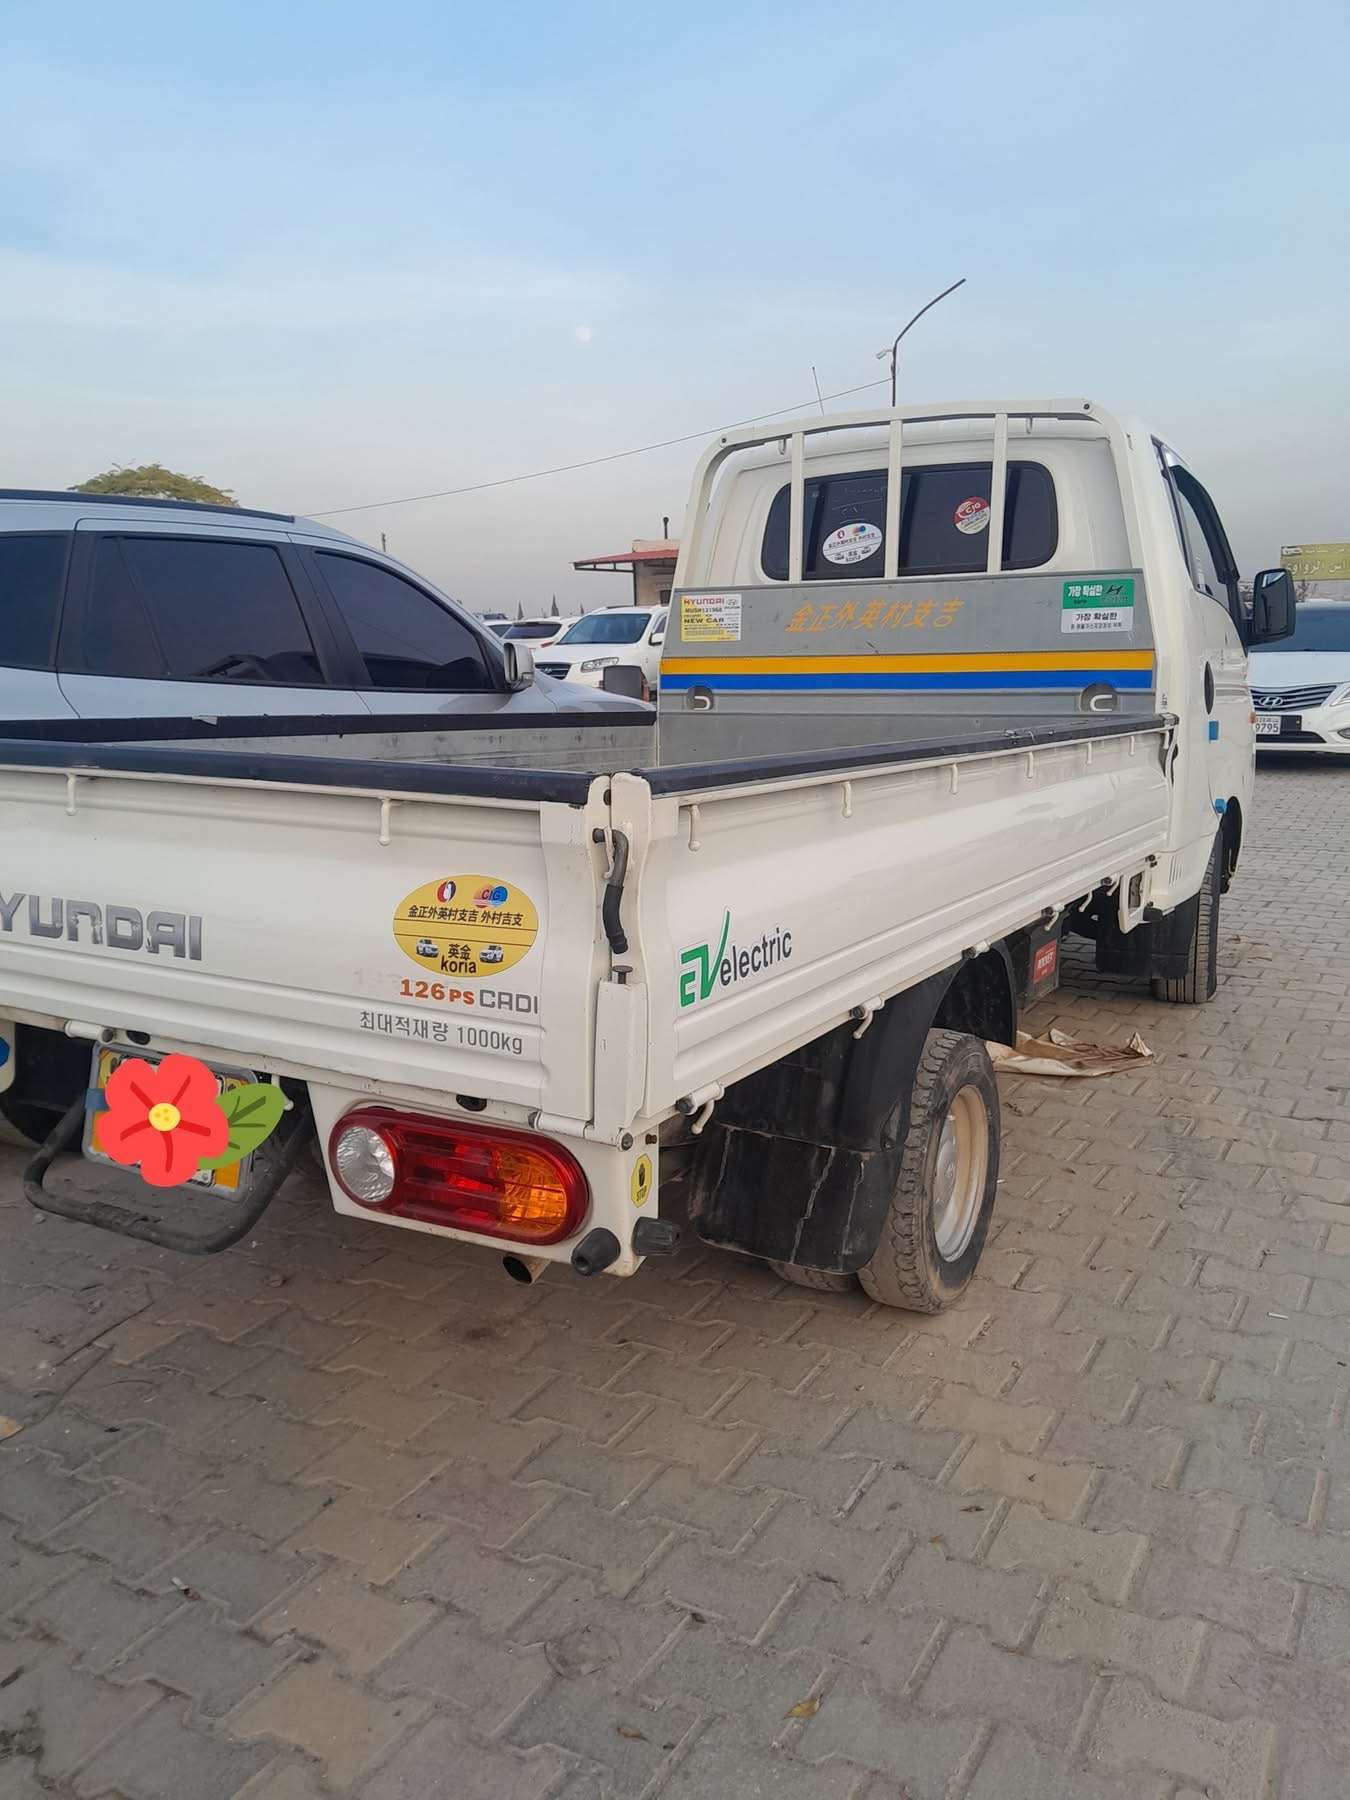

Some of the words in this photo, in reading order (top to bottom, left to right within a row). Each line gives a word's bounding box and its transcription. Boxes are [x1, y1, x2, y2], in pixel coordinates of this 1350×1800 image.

[1255, 723, 1279, 733] 9795
[440, 955, 477, 974] koria
[720, 927, 792, 986] electric
[359, 1011, 449, 1042] 최대적재량
[457, 1026, 523, 1055] 1000kg
